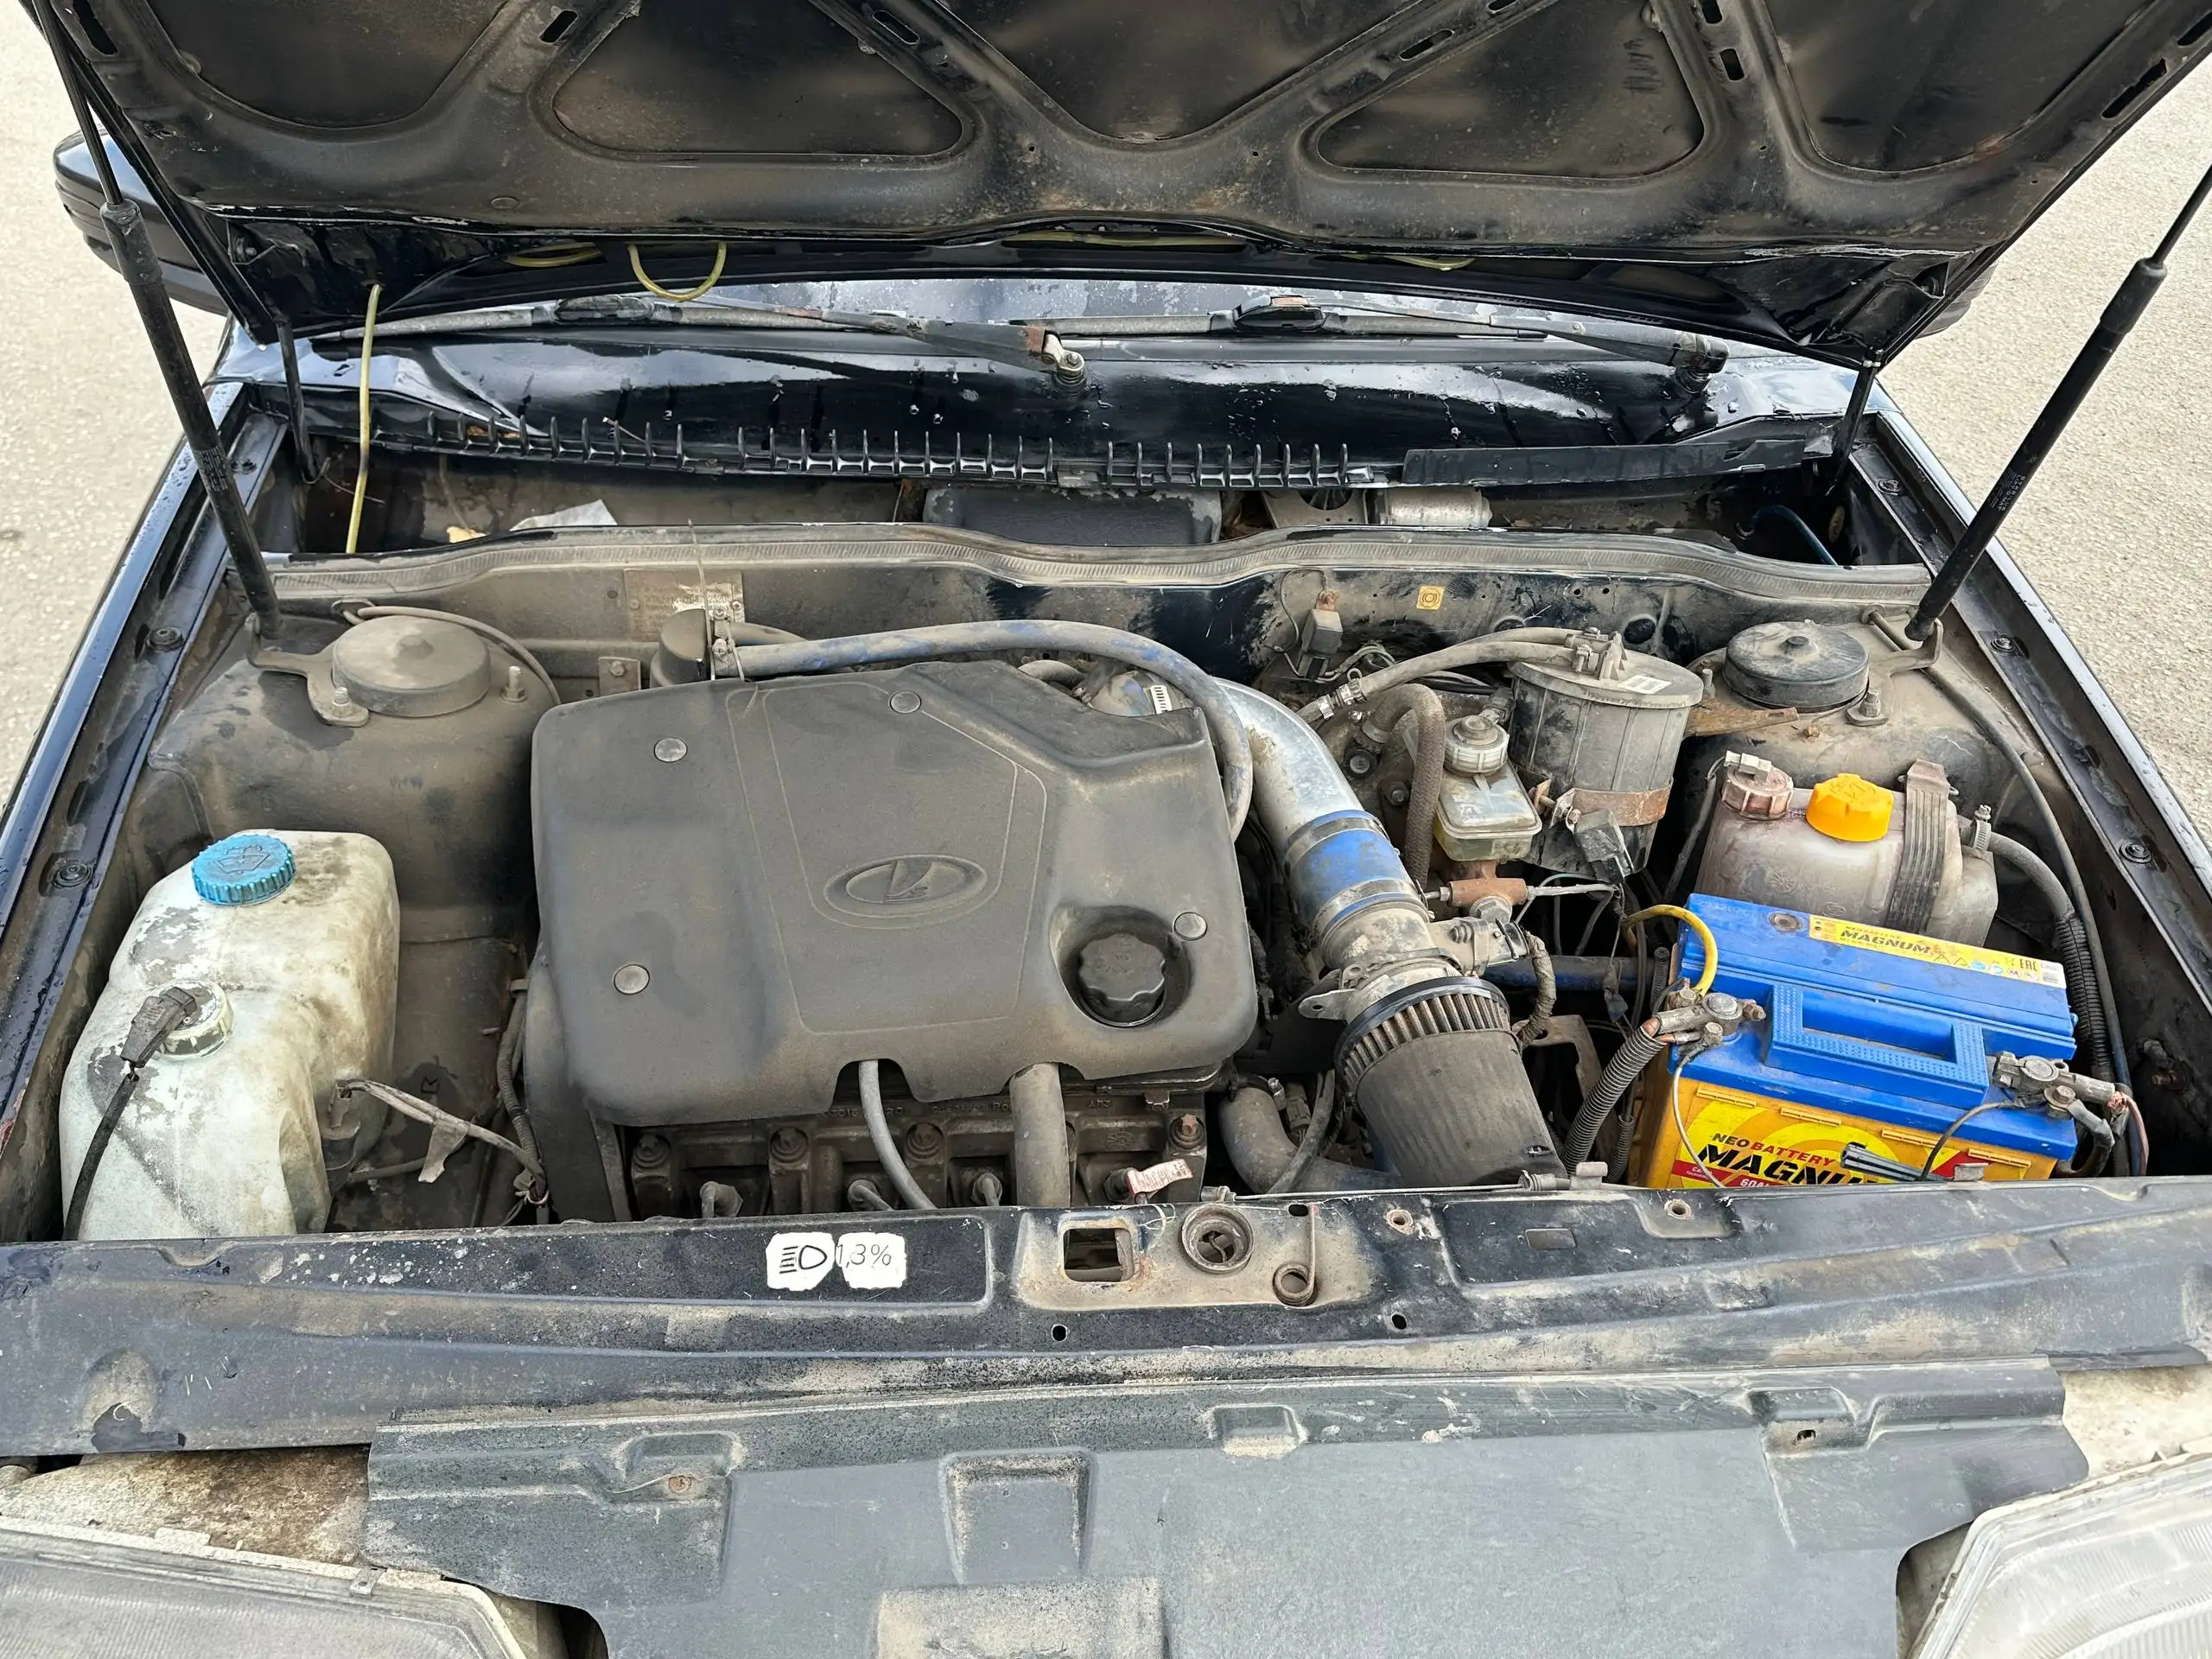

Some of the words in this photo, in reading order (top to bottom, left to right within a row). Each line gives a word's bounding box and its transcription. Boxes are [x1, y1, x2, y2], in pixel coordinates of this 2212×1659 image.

[1840, 930, 1930, 954] MAGNUM
[1697, 1143, 1878, 1185] MAGN
[835, 1243, 893, 1268] 1,3%
